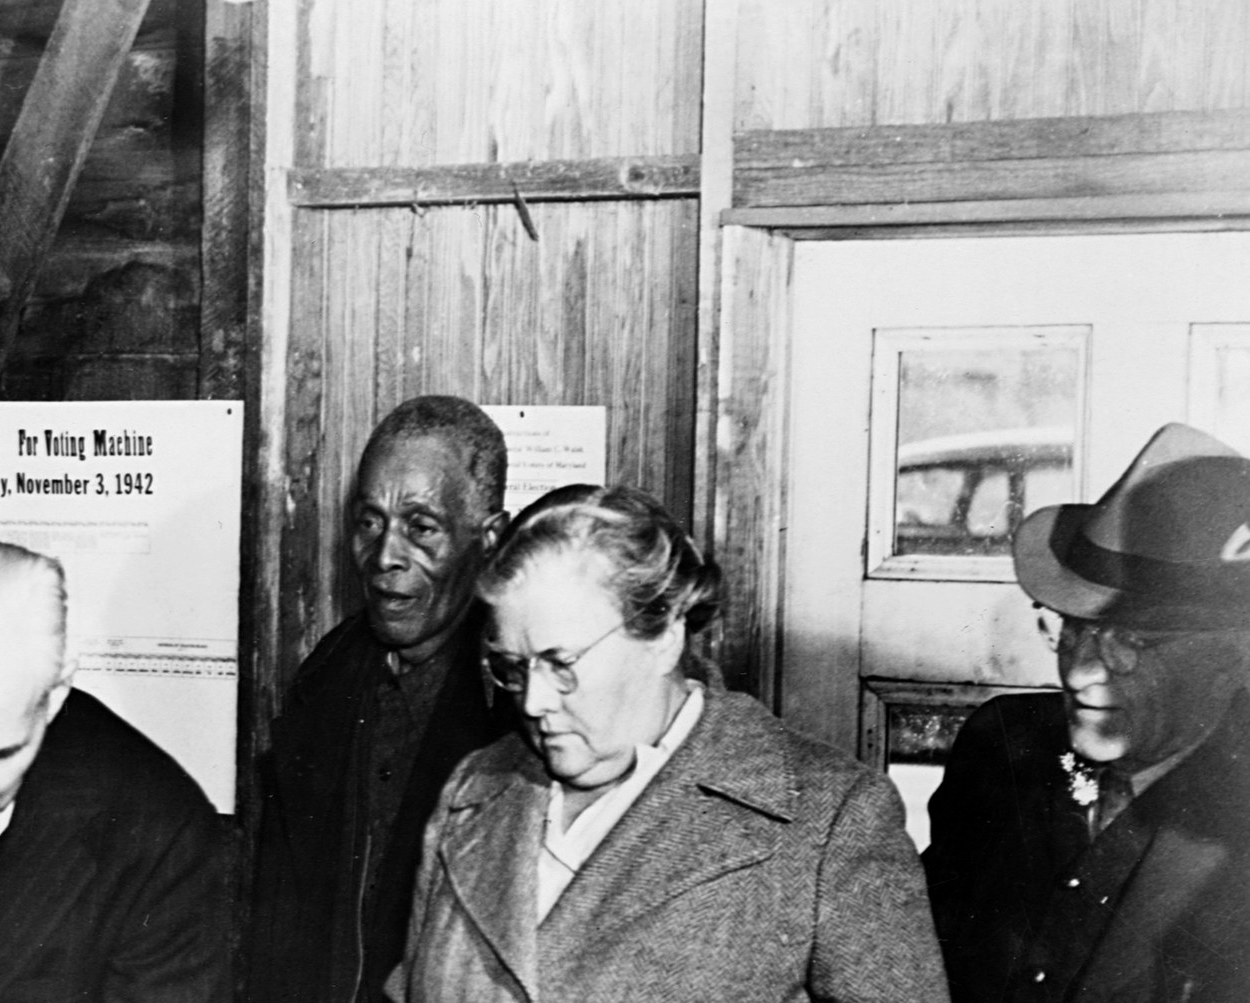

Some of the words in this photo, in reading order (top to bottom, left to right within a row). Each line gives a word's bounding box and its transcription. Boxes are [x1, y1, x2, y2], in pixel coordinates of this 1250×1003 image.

[18, 429, 39, 456] For
[44, 429, 86, 461] Voting
[93, 429, 153, 456] Machine
[16, 472, 90, 494] November
[95, 473, 110, 496] 3,
[115, 473, 154, 495] 1942
